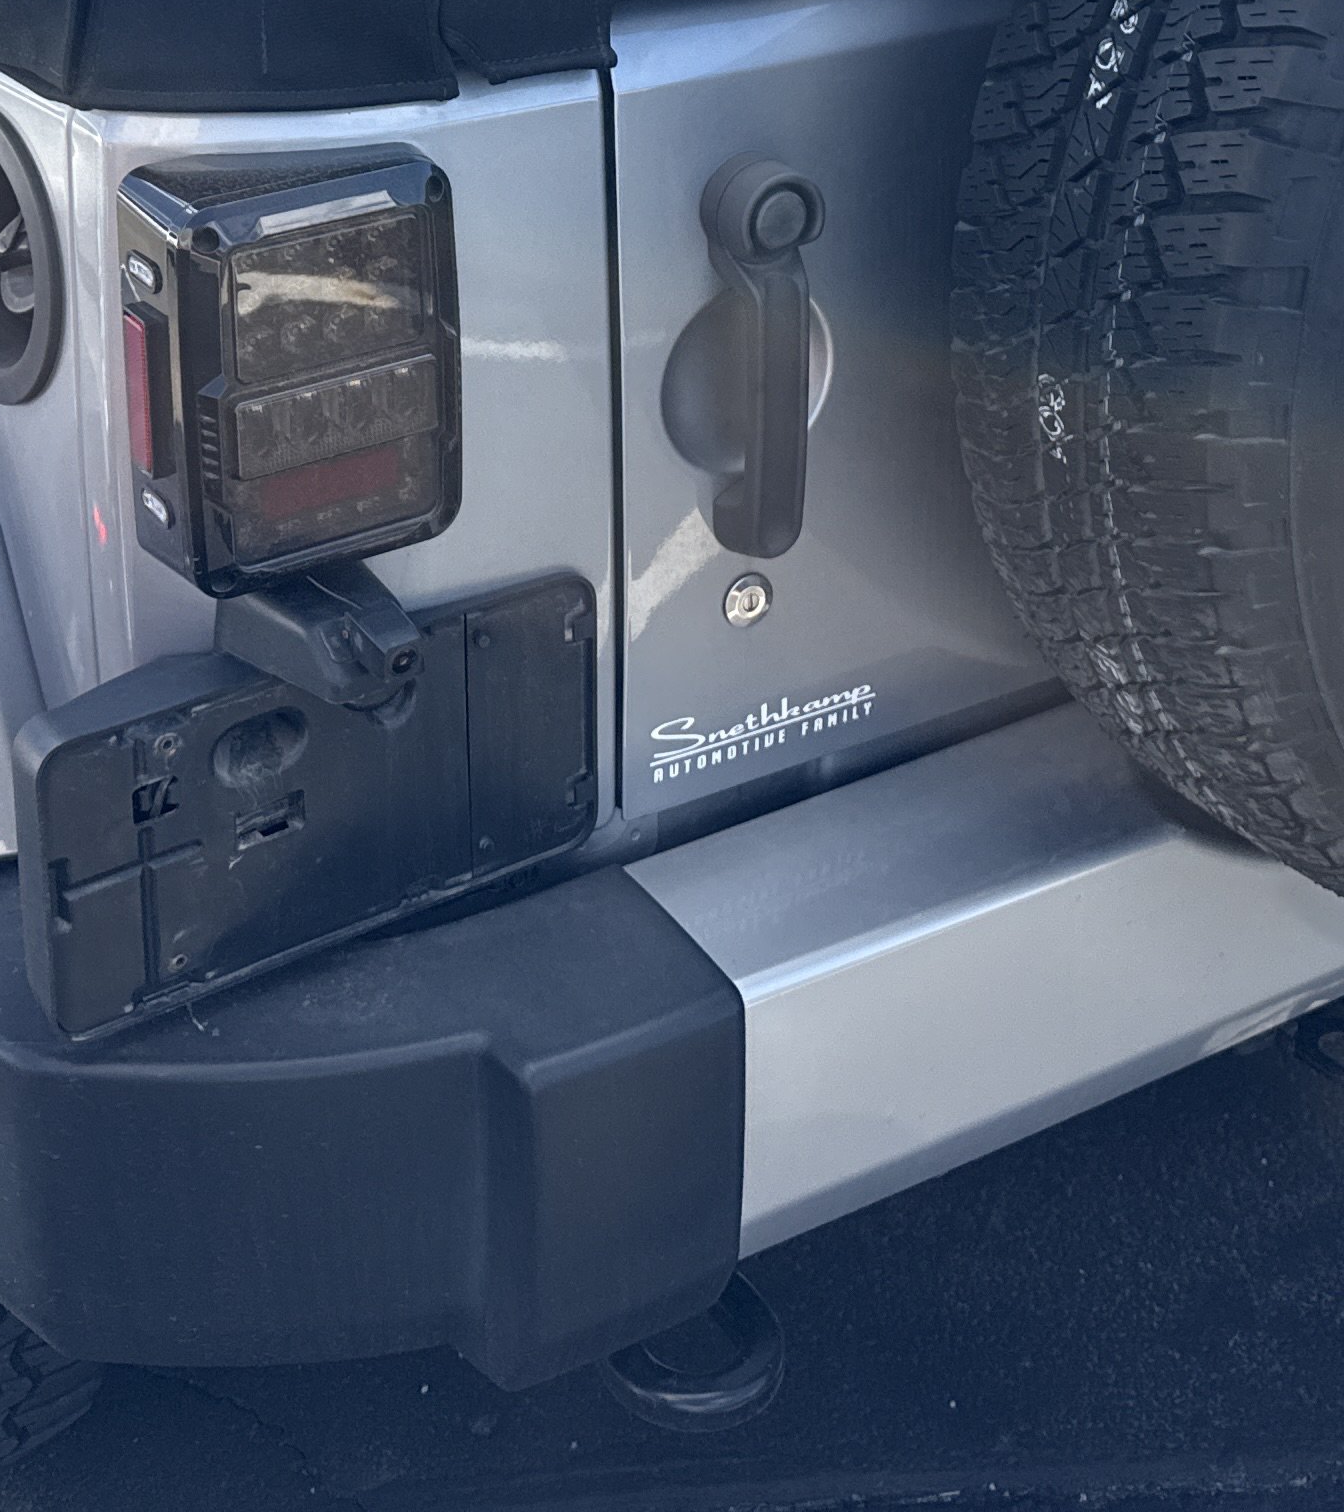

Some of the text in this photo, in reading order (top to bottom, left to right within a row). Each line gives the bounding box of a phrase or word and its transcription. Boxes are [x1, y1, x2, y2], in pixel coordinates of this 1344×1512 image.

[650, 684, 872, 760] Snethkamp
[653, 700, 874, 784] AUTOMOTIVE FAMILY
